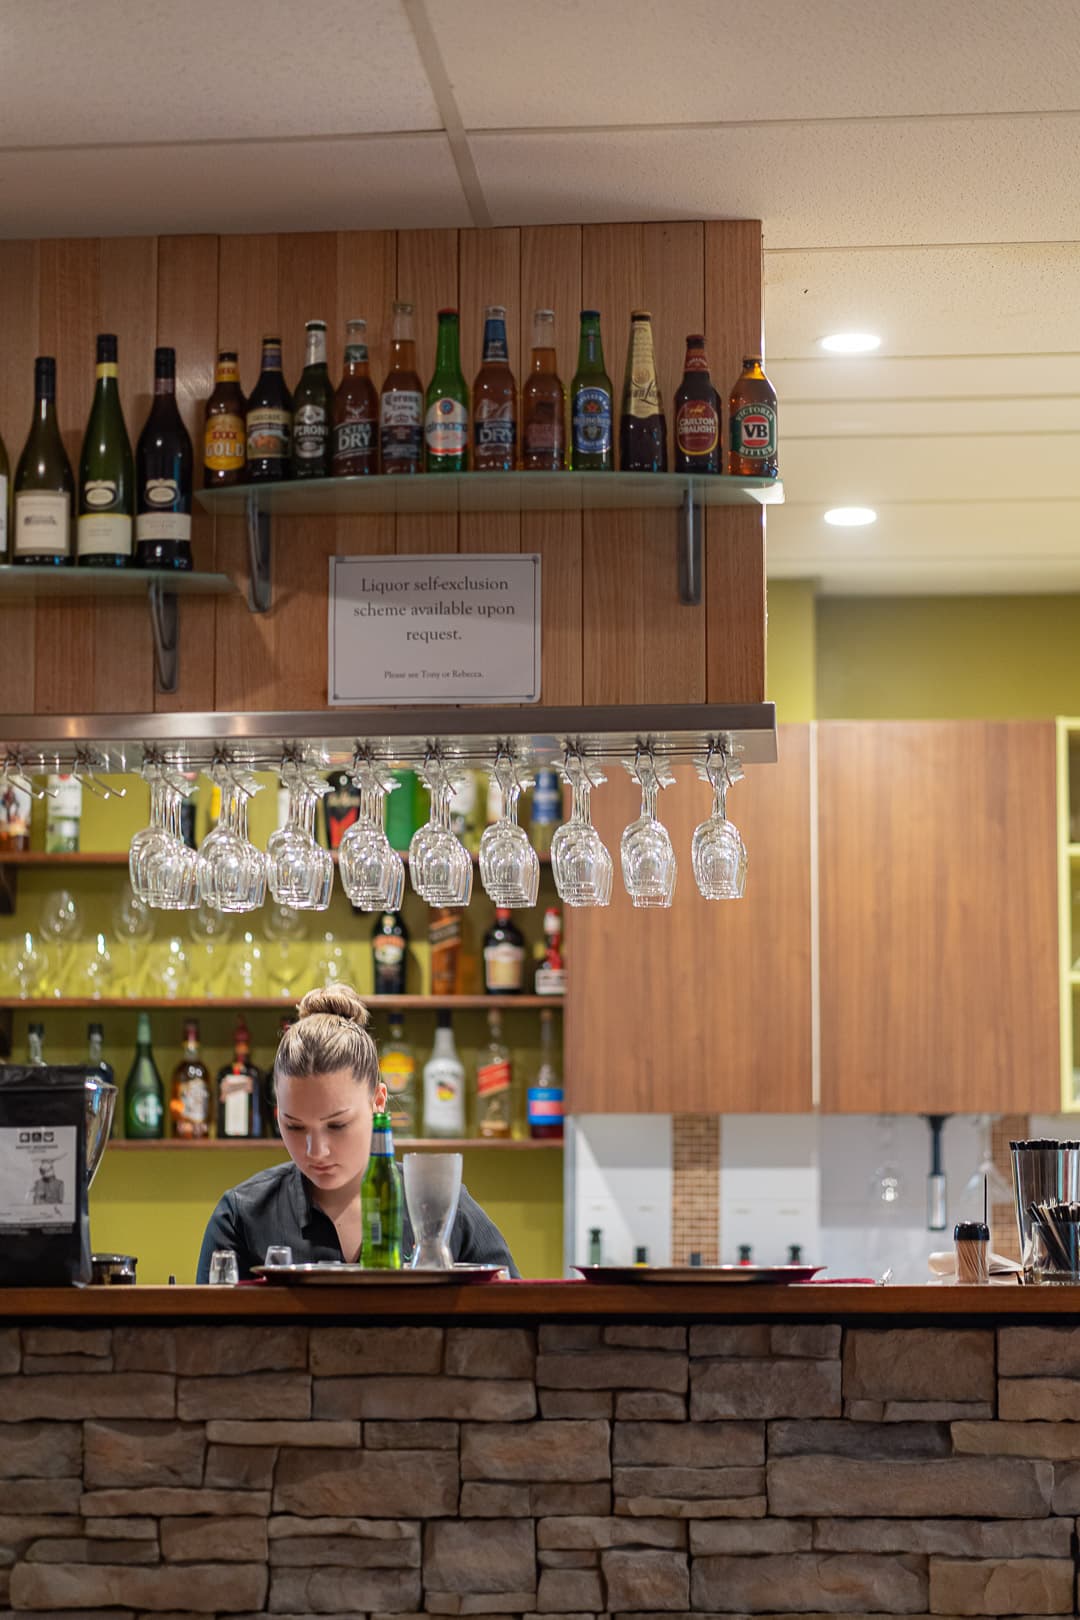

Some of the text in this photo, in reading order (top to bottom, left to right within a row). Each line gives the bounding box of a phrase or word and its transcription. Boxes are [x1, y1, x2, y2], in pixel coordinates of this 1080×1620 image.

[736, 407, 774, 421] VICTORIA
[679, 417, 714, 426] CARLTON
[339, 423, 371, 435] EXTRA
[480, 429, 513, 442] DRY
[678, 425, 716, 434] DRAUGHT
[743, 424, 768, 438] VB
[338, 431, 371, 451] DRY
[207, 440, 244, 457] GOLD
[738, 446, 775, 457] BITTER
[361, 576, 509, 594] Liquor self-exclusion
[353, 601, 516, 618] scheme available upon
[406, 630, 463, 644] request.
[384, 670, 406, 679] Please
[407, 671, 419, 679] see
[421, 670, 440, 680] Tony
[441, 671, 450, 679] or
